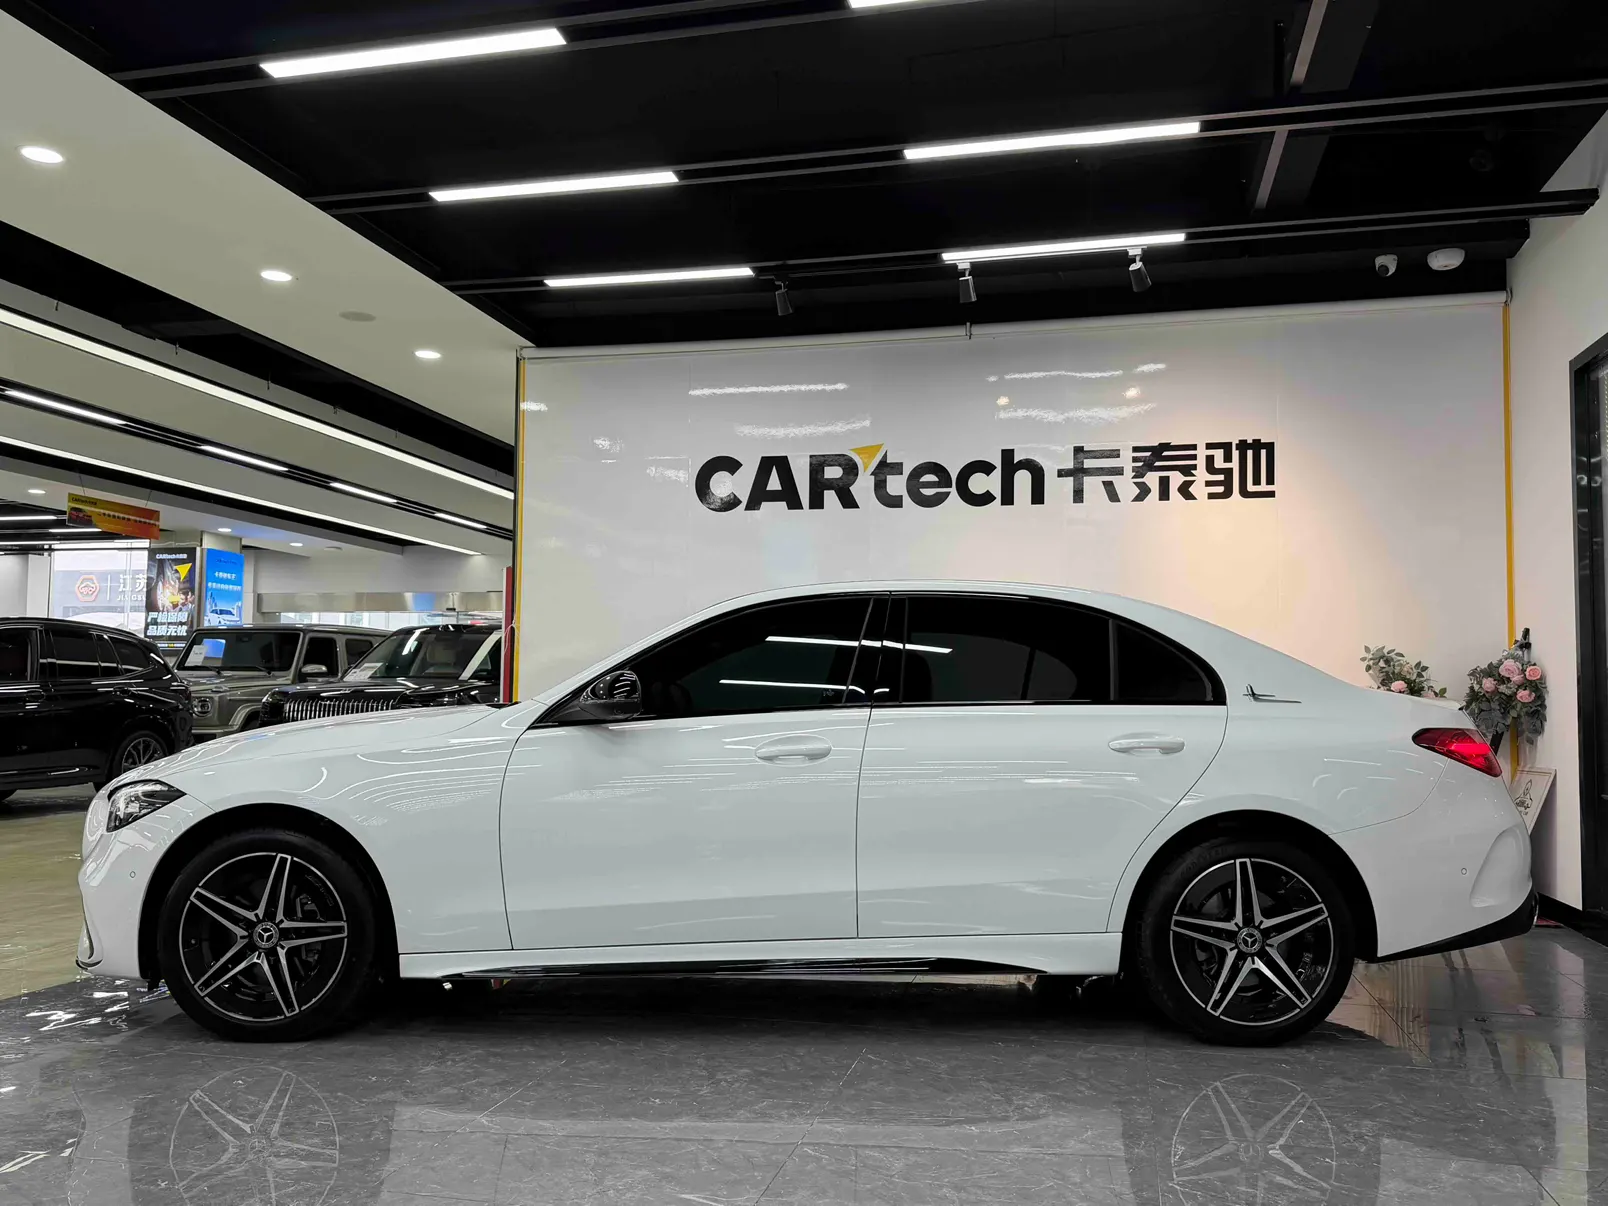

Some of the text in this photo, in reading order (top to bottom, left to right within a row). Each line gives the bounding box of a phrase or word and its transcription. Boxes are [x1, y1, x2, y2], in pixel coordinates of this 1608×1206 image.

[694, 438, 1276, 513] CARtech 卡泰驰
